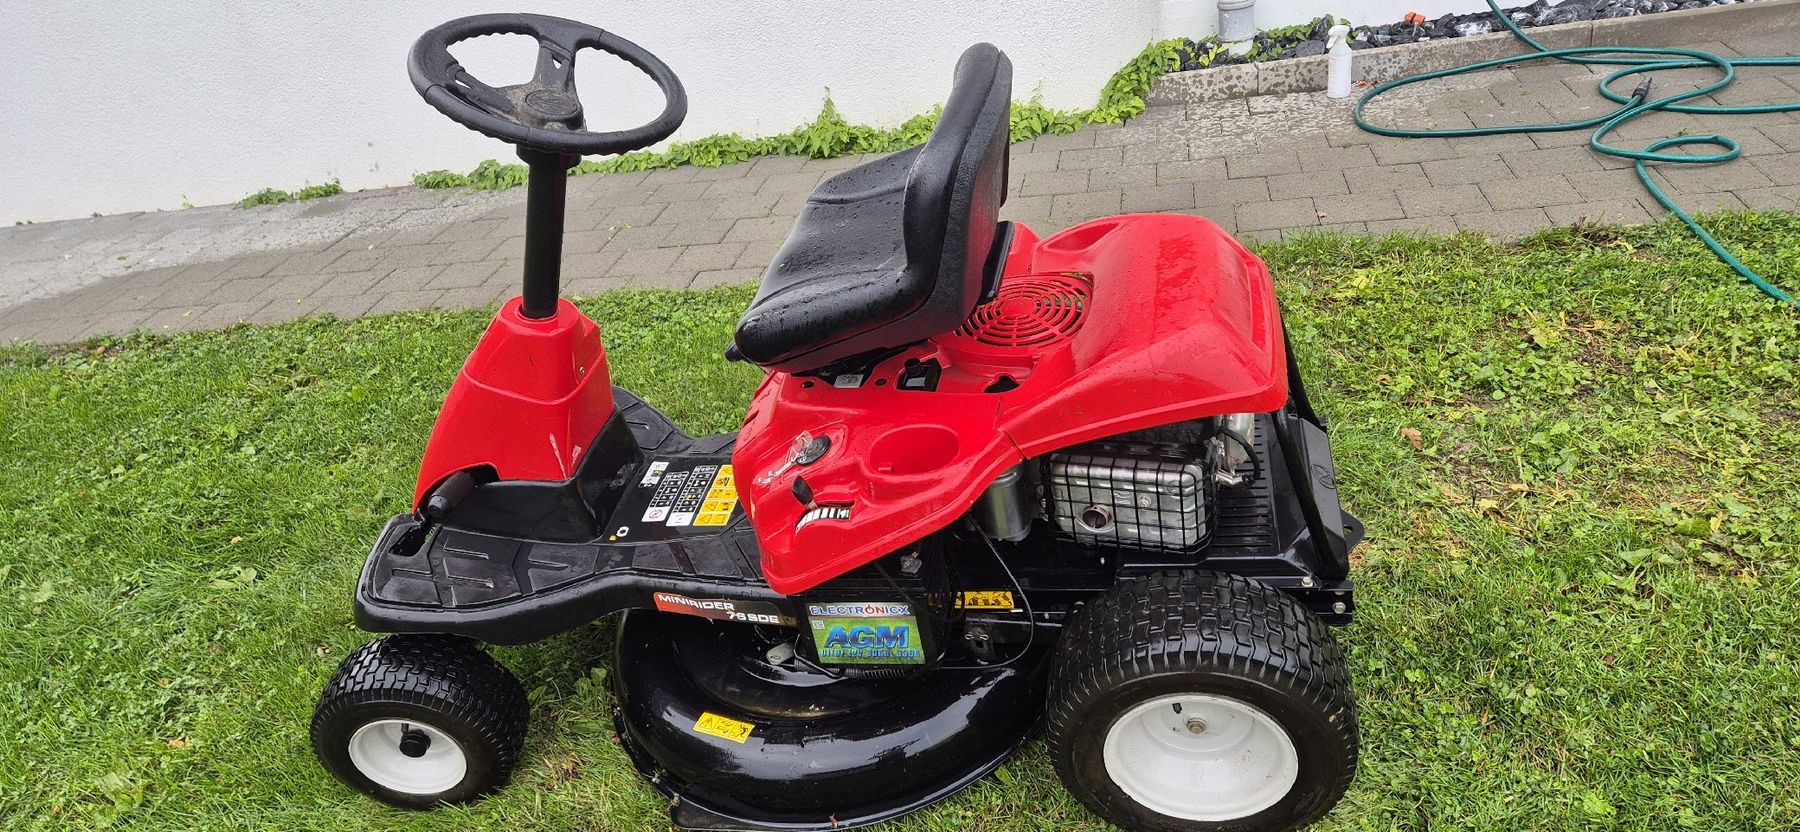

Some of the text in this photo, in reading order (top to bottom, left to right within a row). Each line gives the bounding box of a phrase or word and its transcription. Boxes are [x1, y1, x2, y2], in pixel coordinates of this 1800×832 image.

[659, 594, 734, 610] MINIRIDER
[809, 604, 910, 615] ELECTRONICX
[824, 625, 910, 648] AGM
